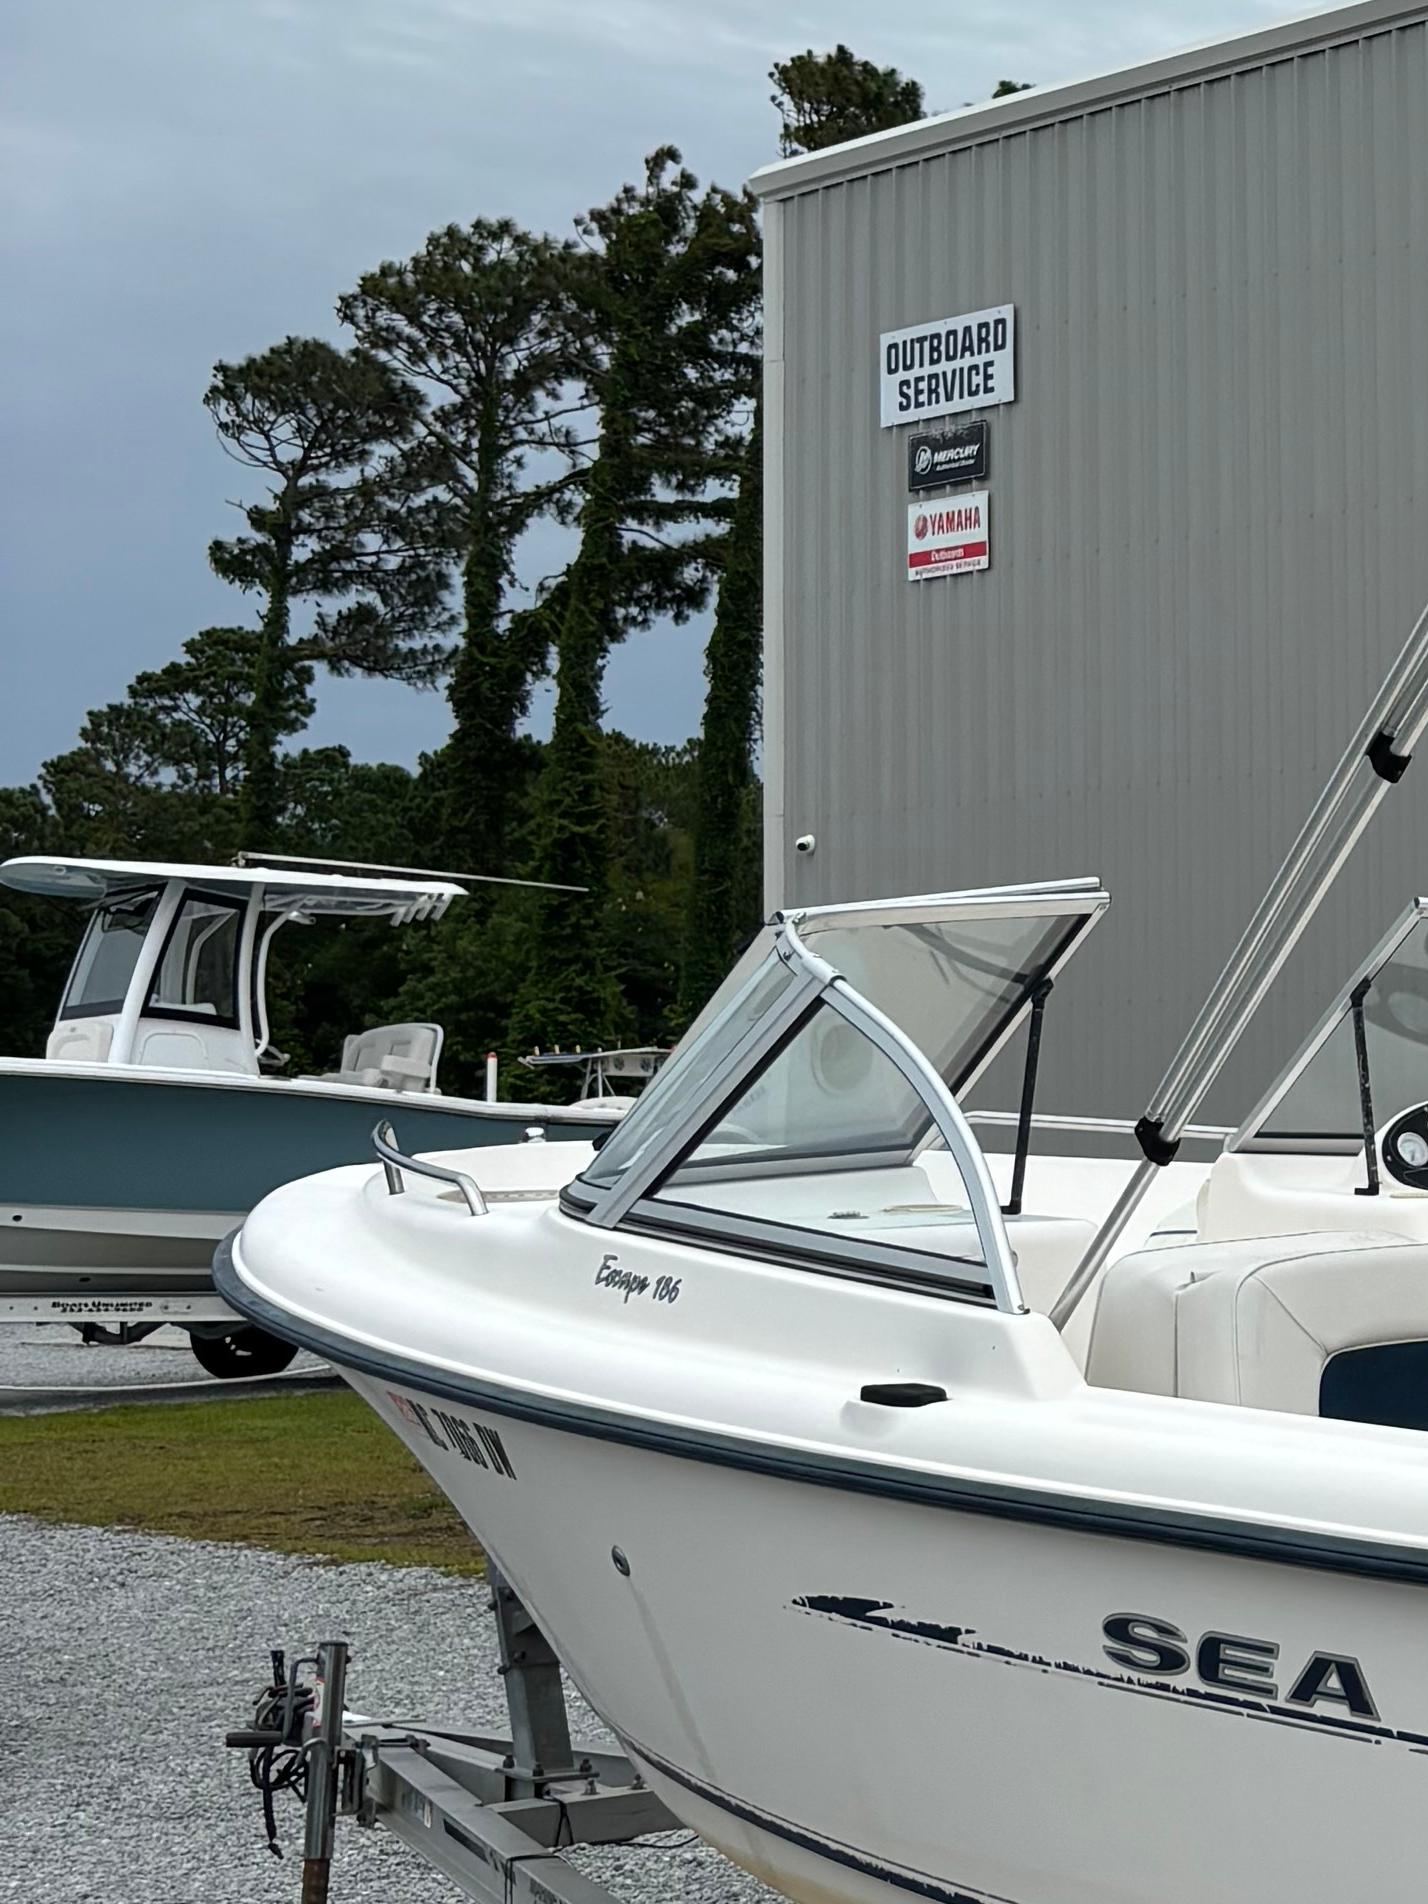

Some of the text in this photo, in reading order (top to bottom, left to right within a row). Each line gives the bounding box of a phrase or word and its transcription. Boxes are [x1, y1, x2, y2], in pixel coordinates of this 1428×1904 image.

[886, 316, 1008, 376] OUTBOARD
[897, 360, 996, 412] SERVICE
[933, 443, 981, 464] MERCURY
[928, 505, 981, 537] YAMAHA
[594, 1254, 682, 1304] Escape 186
[1100, 1611, 1382, 1721] SEA
